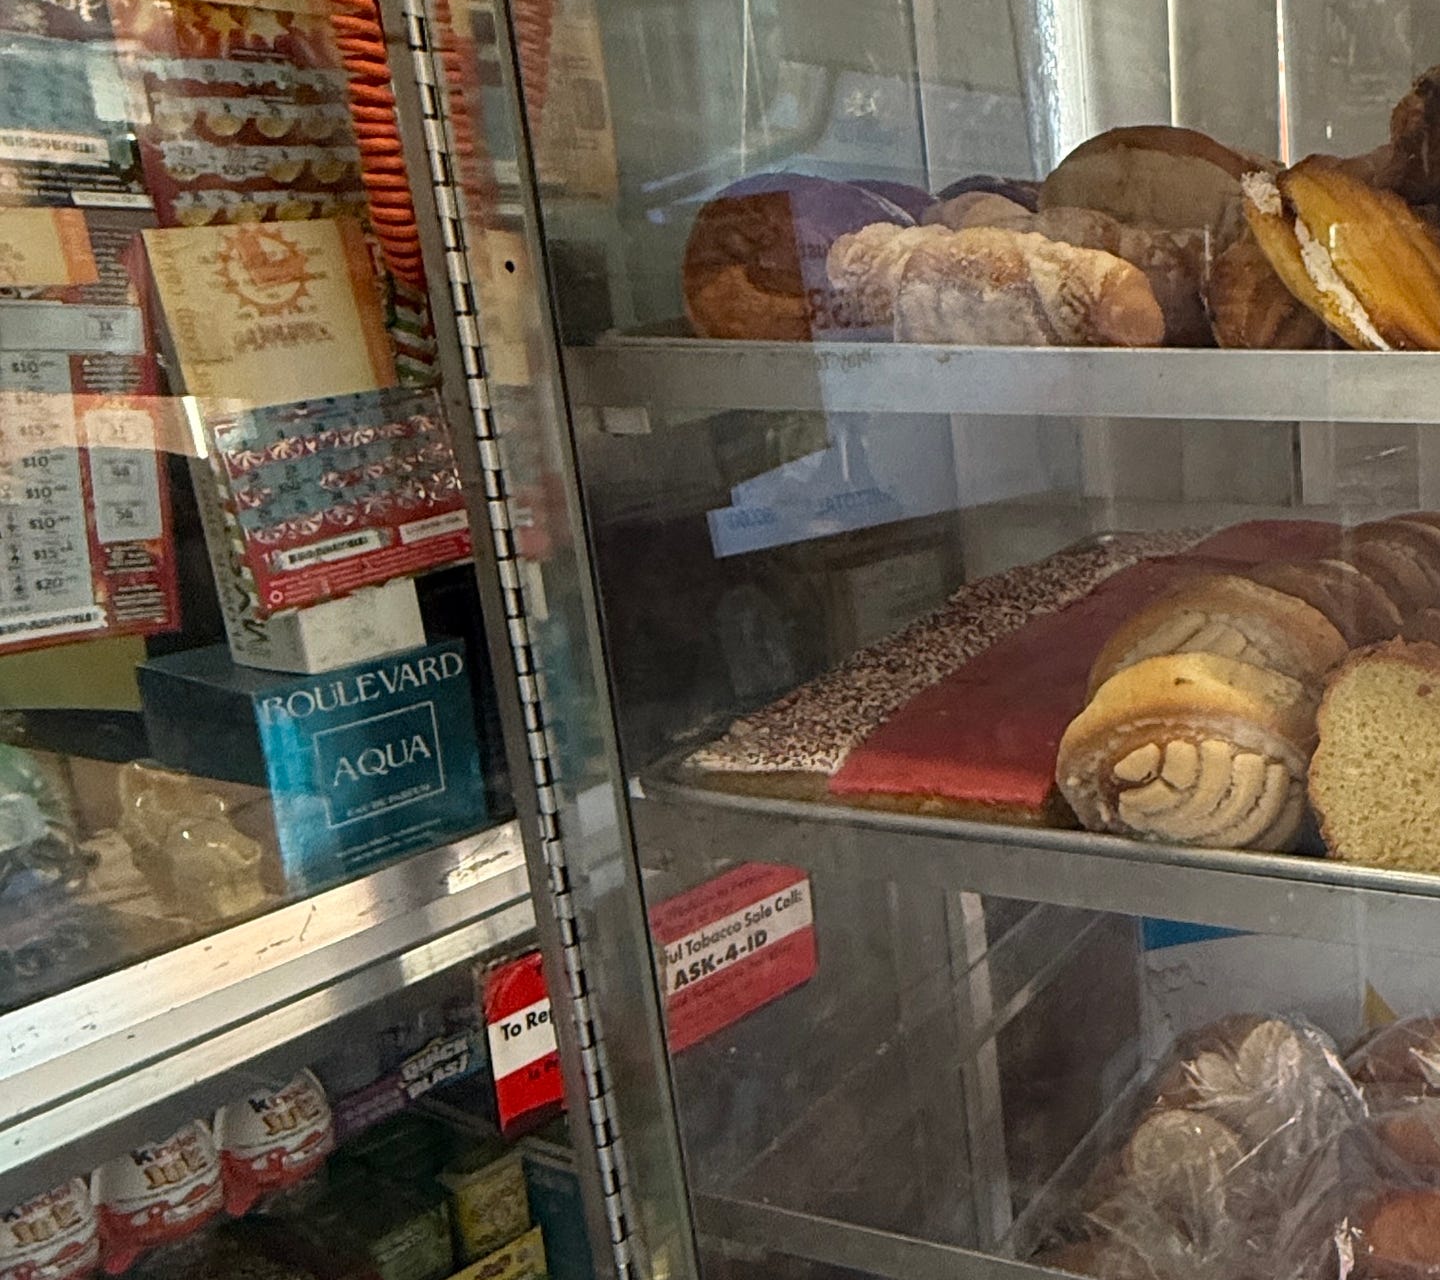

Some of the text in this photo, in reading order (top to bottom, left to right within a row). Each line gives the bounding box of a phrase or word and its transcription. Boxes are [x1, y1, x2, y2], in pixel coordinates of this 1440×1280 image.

[332, 733, 432, 788] AQUA
[500, 1020, 523, 1042] To
[684, 921, 743, 957] Tobacco
[744, 903, 773, 927] Sale
[673, 928, 769, 991] ASK-4-ID
